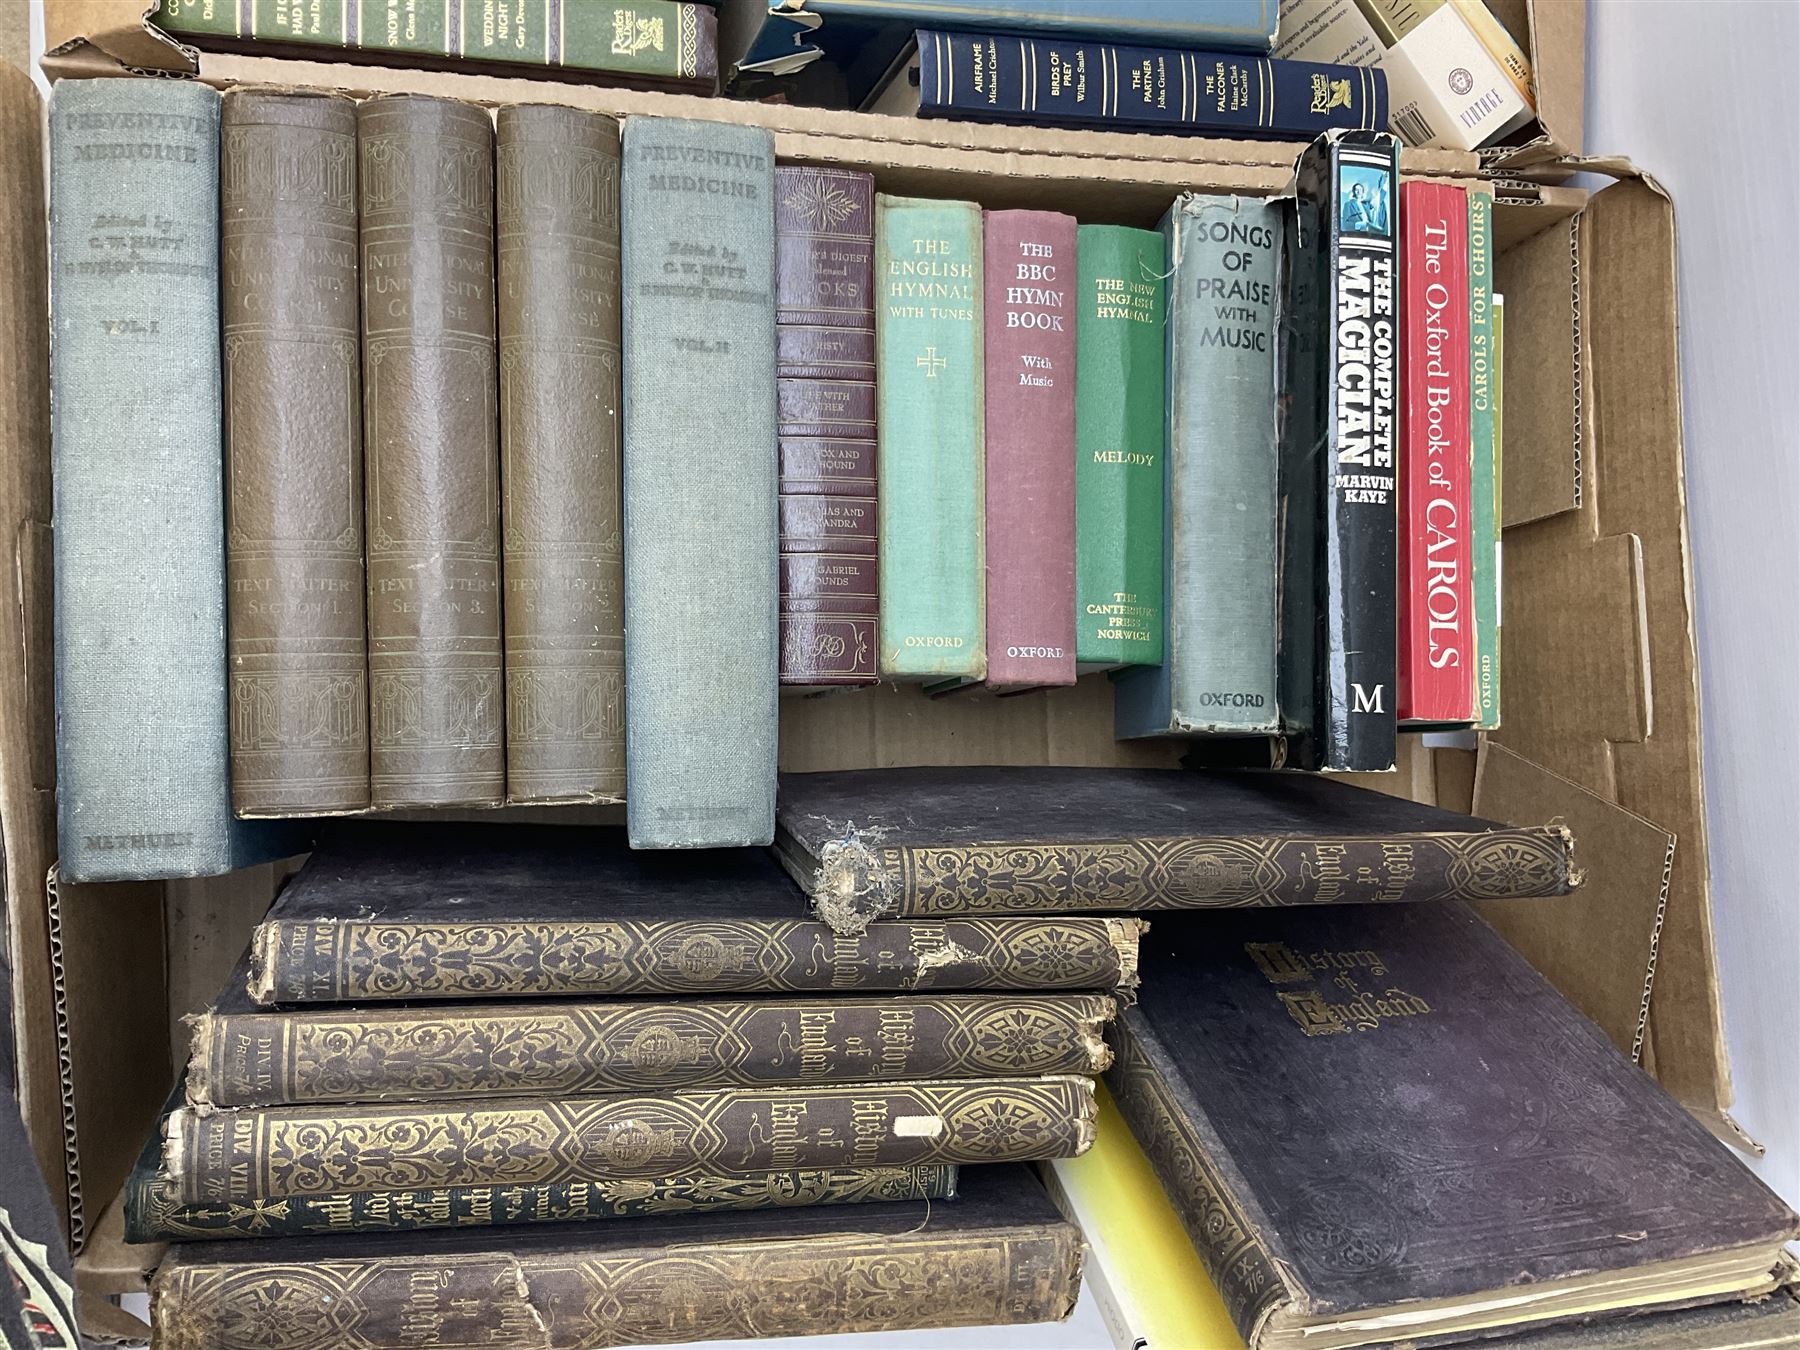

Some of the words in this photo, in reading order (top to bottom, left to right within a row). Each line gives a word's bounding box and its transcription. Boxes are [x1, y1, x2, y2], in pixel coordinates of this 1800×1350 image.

[293, 8, 303, 35] HAD
[311, 13, 320, 34] Paul
[387, 9, 398, 46] SNOW
[498, 2, 508, 39] NIGHT
[1299, 23, 1309, 33] and
[1308, 6, 1332, 26] beginners
[516, 25, 525, 48] Gary
[1050, 51, 1059, 65] OF
[1341, 49, 1350, 60] and
[1349, 43, 1358, 52] the
[1365, 44, 1376, 56] and
[973, 43, 983, 93] AIRFRAME
[1076, 50, 1085, 73] Smith
[1157, 57, 1166, 88] Grisham
[1051, 66, 1060, 96] BIRDS
[1063, 62, 1072, 87] PREY
[1132, 69, 1141, 90] THE
[1143, 60, 1152, 103] PARTNER
[1206, 75, 1214, 95] THE
[1230, 64, 1238, 85] Clark
[988, 71, 997, 104] Michael
[1077, 74, 1085, 103] Wilbur
[1216, 62, 1225, 112] FALCONER
[1240, 69, 1248, 107] McCarthy
[1157, 90, 1166, 109] John
[1459, 88, 1504, 129] VINTAGE
[66, 112, 210, 133] PREVENTIVE
[73, 144, 197, 163] MEDICINE
[639, 146, 766, 172] PREVENTIVE
[649, 175, 758, 200] MEDICINE
[1197, 222, 1272, 250] SONGS
[1472, 201, 1485, 277] CHOIRS
[666, 241, 717, 256] Edited
[722, 246, 738, 263] by
[831, 252, 869, 264] DIGEST
[913, 240, 951, 255] THE
[1019, 242, 1053, 258] THE
[1424, 220, 1447, 275] The
[890, 261, 973, 278] ENGLISH
[1222, 251, 1252, 272] OF
[231, 271, 347, 293] UNIVSITY
[1016, 264, 1056, 282] BBC
[376, 275, 484, 299] UNIRSITY
[818, 281, 858, 298] OKS
[890, 282, 973, 300] HYMNAL
[1006, 287, 1064, 308] HYMN
[1096, 279, 1124, 291] THE
[1129, 281, 1156, 297] NEW
[1196, 278, 1270, 306] PRAISE
[1373, 258, 1392, 316] THE
[243, 292, 329, 319] CORSE
[388, 298, 468, 321] COSE
[1097, 293, 1153, 310] ENGLISH
[1474, 285, 1486, 324] FOR
[890, 307, 924, 318] WITH
[930, 307, 973, 321] TUNES
[1006, 311, 1064, 332] BOOK
[1097, 307, 1153, 324] HYMNAL
[1215, 306, 1257, 323] WITH
[1200, 326, 1266, 352] MUSIC
[1425, 283, 1449, 377] Oxford
[815, 342, 846, 351] RISTY
[1021, 355, 1052, 369] With
[1338, 255, 1371, 467] MAGICIAN
[1019, 373, 1053, 387] Music
[1474, 334, 1487, 411] CAROLS
[823, 391, 850, 401] WITH
[1373, 321, 1392, 468] COMPLETE
[818, 403, 845, 412] THER
[1427, 386, 1451, 454] Book
[839, 450, 860, 459] AND
[1093, 451, 1154, 467] MELODY
[1335, 475, 1394, 491] MARVIN
[1429, 461, 1451, 491] of
[1344, 489, 1387, 505] KAYE
[820, 519, 858, 528] ANDRA
[843, 508, 865, 517] AND
[815, 577, 849, 586] OUNDS
[817, 566, 860, 575] GABRIEL
[1426, 498, 1459, 669] CAROLS
[392, 599, 461, 613] SECON
[1114, 592, 1137, 603] THE
[1086, 603, 1158, 618] CANTERBURY
[1109, 616, 1142, 628] PRESS
[904, 635, 964, 648] OXFORD
[1097, 629, 1151, 642] NORWICH
[1007, 646, 1065, 659] OXFORD
[1482, 654, 1491, 709] OXFORD
[1199, 692, 1265, 708] OXFORD
[1351, 683, 1385, 713] M
[1312, 843, 1350, 902] England
[1357, 867, 1379, 883] of
[1373, 843, 1415, 901] History
[290, 925, 308, 966] PRICE
[315, 925, 334, 956] DIV.
[1244, 941, 1389, 984] History
[1333, 969, 1358, 993] of
[1276, 985, 1437, 1036] England
[799, 1010, 836, 1077] England
[845, 1037, 872, 1056] of
[873, 1009, 915, 1076] History
[233, 1119, 253, 1154] DIV.
[771, 1101, 808, 1167] England
[817, 1128, 844, 1148] of
[845, 1099, 888, 1165] History
[208, 1122, 224, 1170] PRICE
